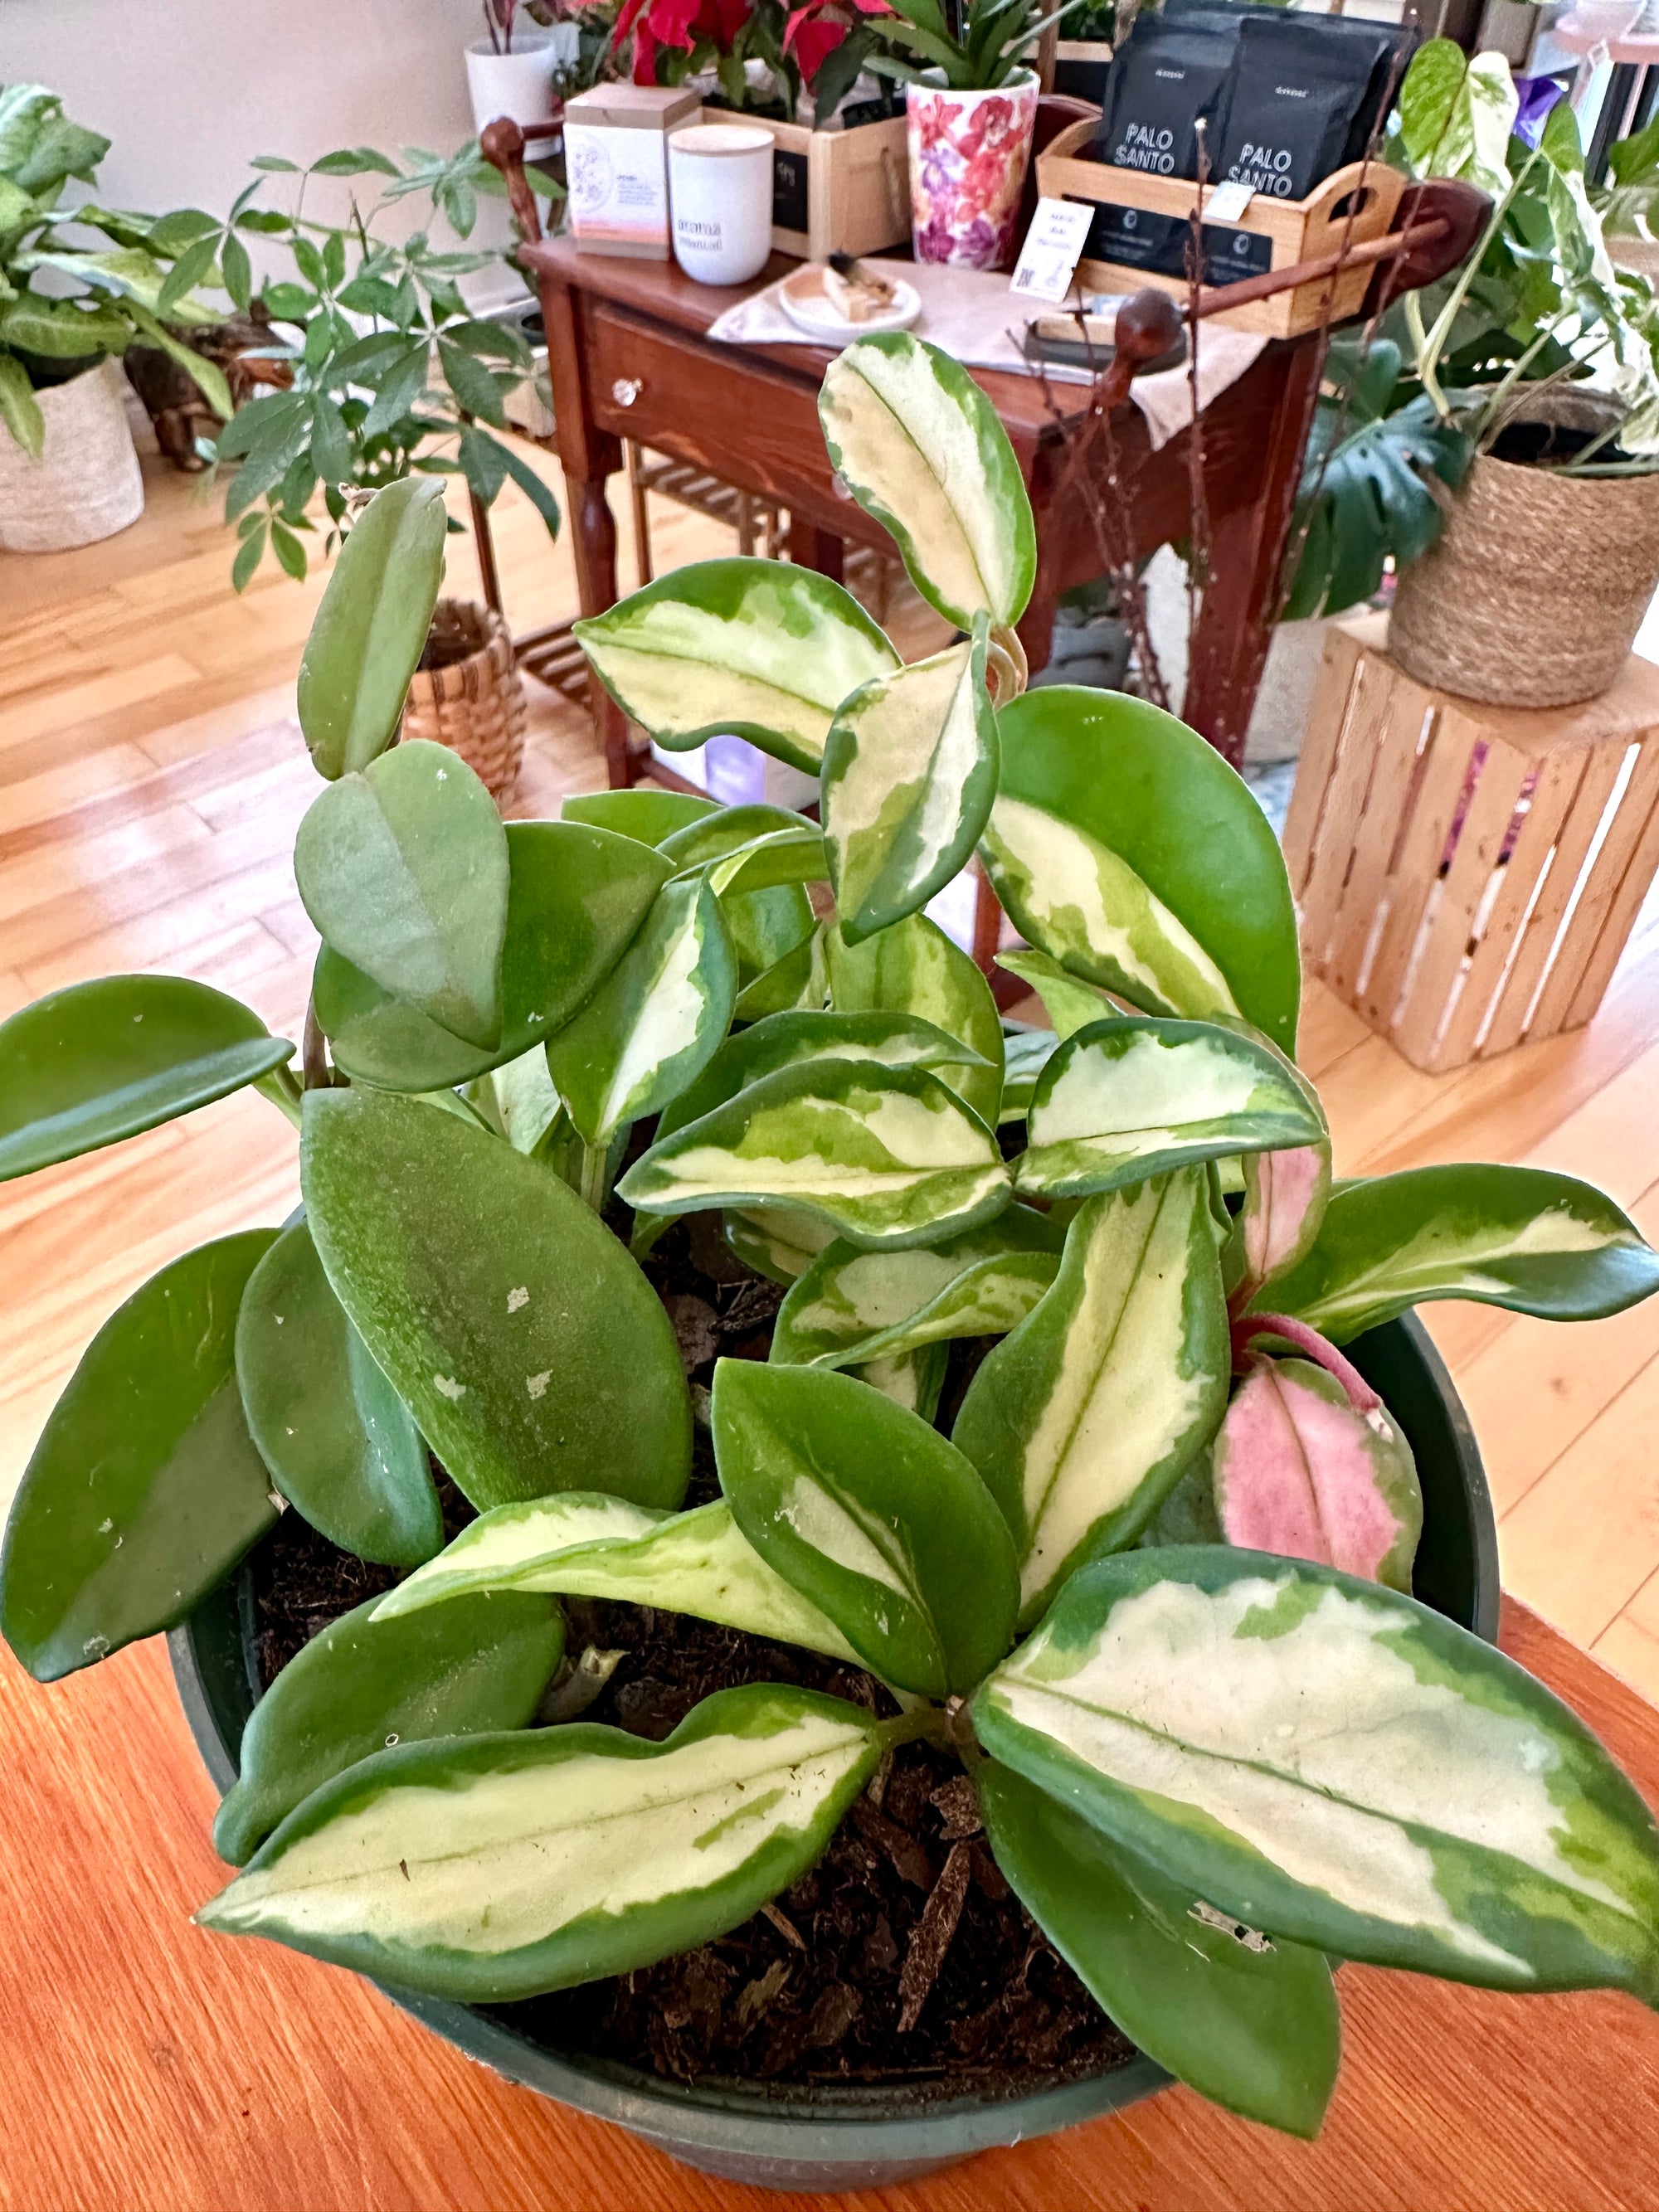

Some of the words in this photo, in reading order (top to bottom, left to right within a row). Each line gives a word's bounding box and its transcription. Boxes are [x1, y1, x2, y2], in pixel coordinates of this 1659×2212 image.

[1125, 122, 1174, 151] PALO
[1114, 144, 1175, 174] SANTO
[1238, 143, 1292, 173] PALO
[1228, 166, 1293, 197] SANTO
